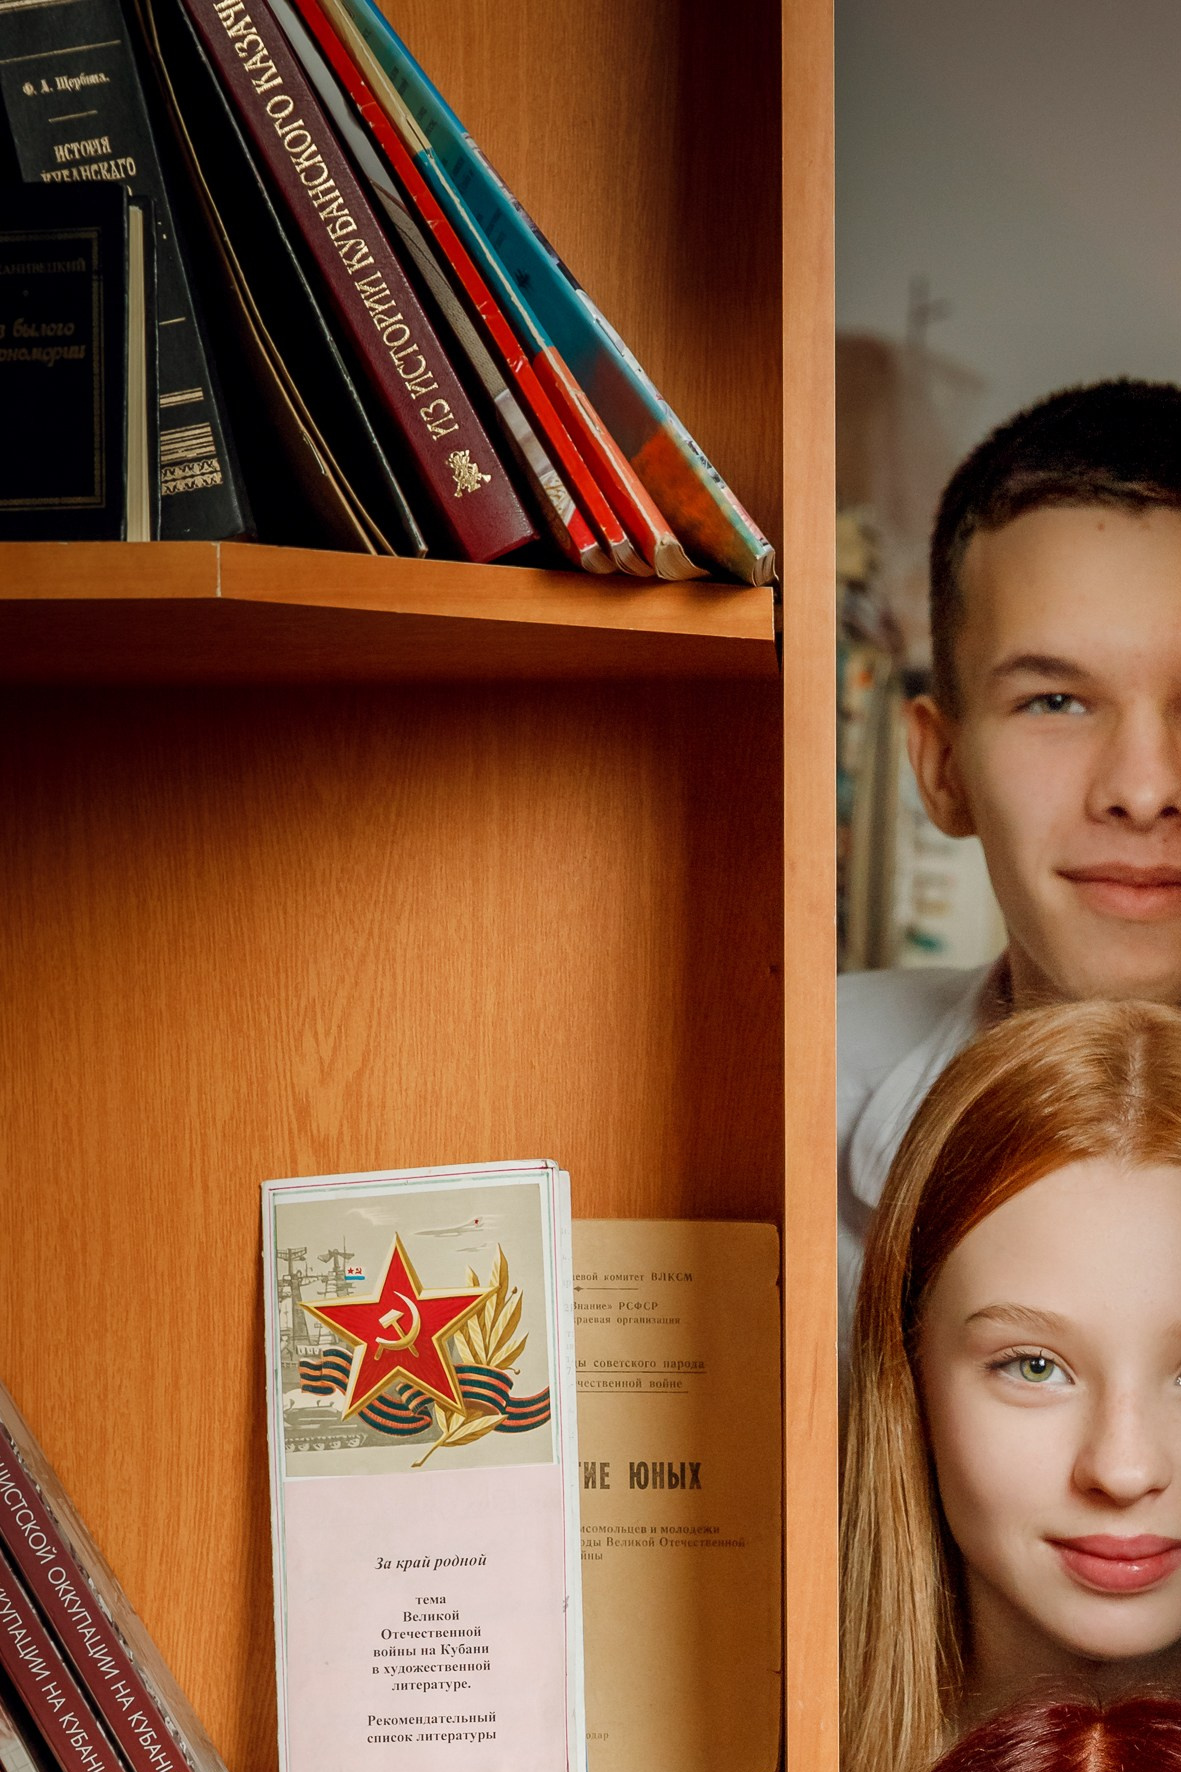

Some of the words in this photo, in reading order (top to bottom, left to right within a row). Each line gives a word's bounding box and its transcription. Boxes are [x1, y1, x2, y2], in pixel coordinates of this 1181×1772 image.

[266, 94, 377, 274] КУБАНСКОГО
[355, 270, 439, 401] ИСТОРИИ
[420, 399, 460, 441] ИЗ
[604, 1273, 645, 1282] комитет
[651, 1272, 694, 1282] ВЛКСМ
[618, 1301, 659, 1312] РСФСР
[616, 1316, 681, 1327] организация
[593, 1360, 657, 1369] советского
[663, 1360, 705, 1371] народа
[649, 1379, 683, 1389] войне
[629, 1462, 703, 1490] ЮНЫХ
[660, 1525, 720, 1536] молодежи
[606, 1536, 655, 1547] Великой
[375, 1557, 392, 1570] За
[396, 1555, 430, 1572] край
[433, 1553, 487, 1572] родной
[415, 1596, 446, 1606] тема
[403, 1609, 460, 1622] Великой
[47, 1566, 121, 1681] ОККУПАЦИИ
[110, 1680, 138, 1712] НА
[380, 1625, 481, 1640] Отечественной
[373, 1645, 416, 1658] войны
[421, 1647, 436, 1656] на
[440, 1642, 489, 1658] Кубани
[371, 1665, 380, 1674] в
[383, 1659, 491, 1677] художественной
[391, 1680, 471, 1693] литературе.
[41, 1681, 67, 1713] НА
[367, 1711, 496, 1727] Рекомендательный
[367, 1733, 412, 1745] список
[416, 1730, 496, 1745] литературы
